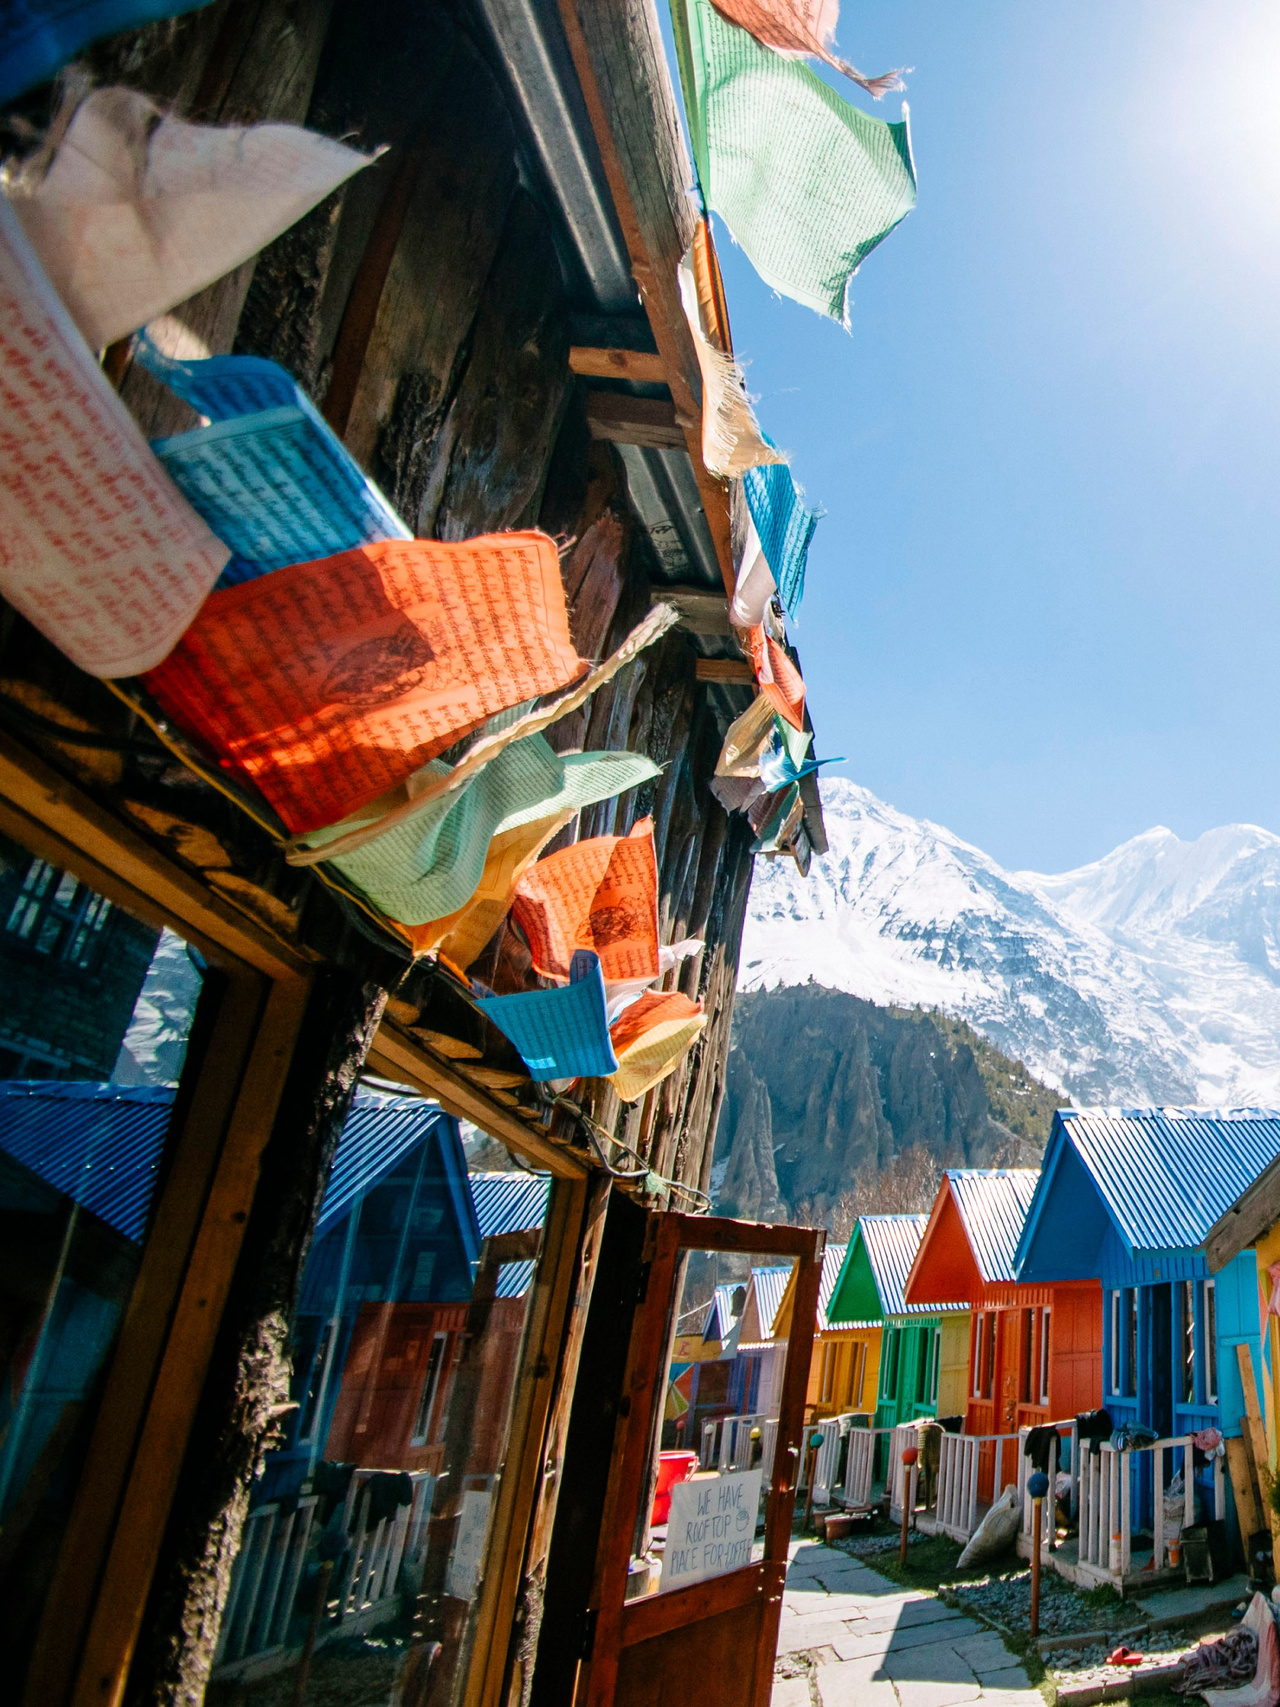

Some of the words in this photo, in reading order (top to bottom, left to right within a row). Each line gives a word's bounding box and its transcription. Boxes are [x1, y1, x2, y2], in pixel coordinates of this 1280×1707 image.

[698, 1489, 712, 1515] WE
[718, 1484, 743, 1511] HAVE
[686, 1515, 731, 1544] ROOFTOP
[671, 1547, 698, 1575] PLACE
[704, 1543, 723, 1569] FOR
